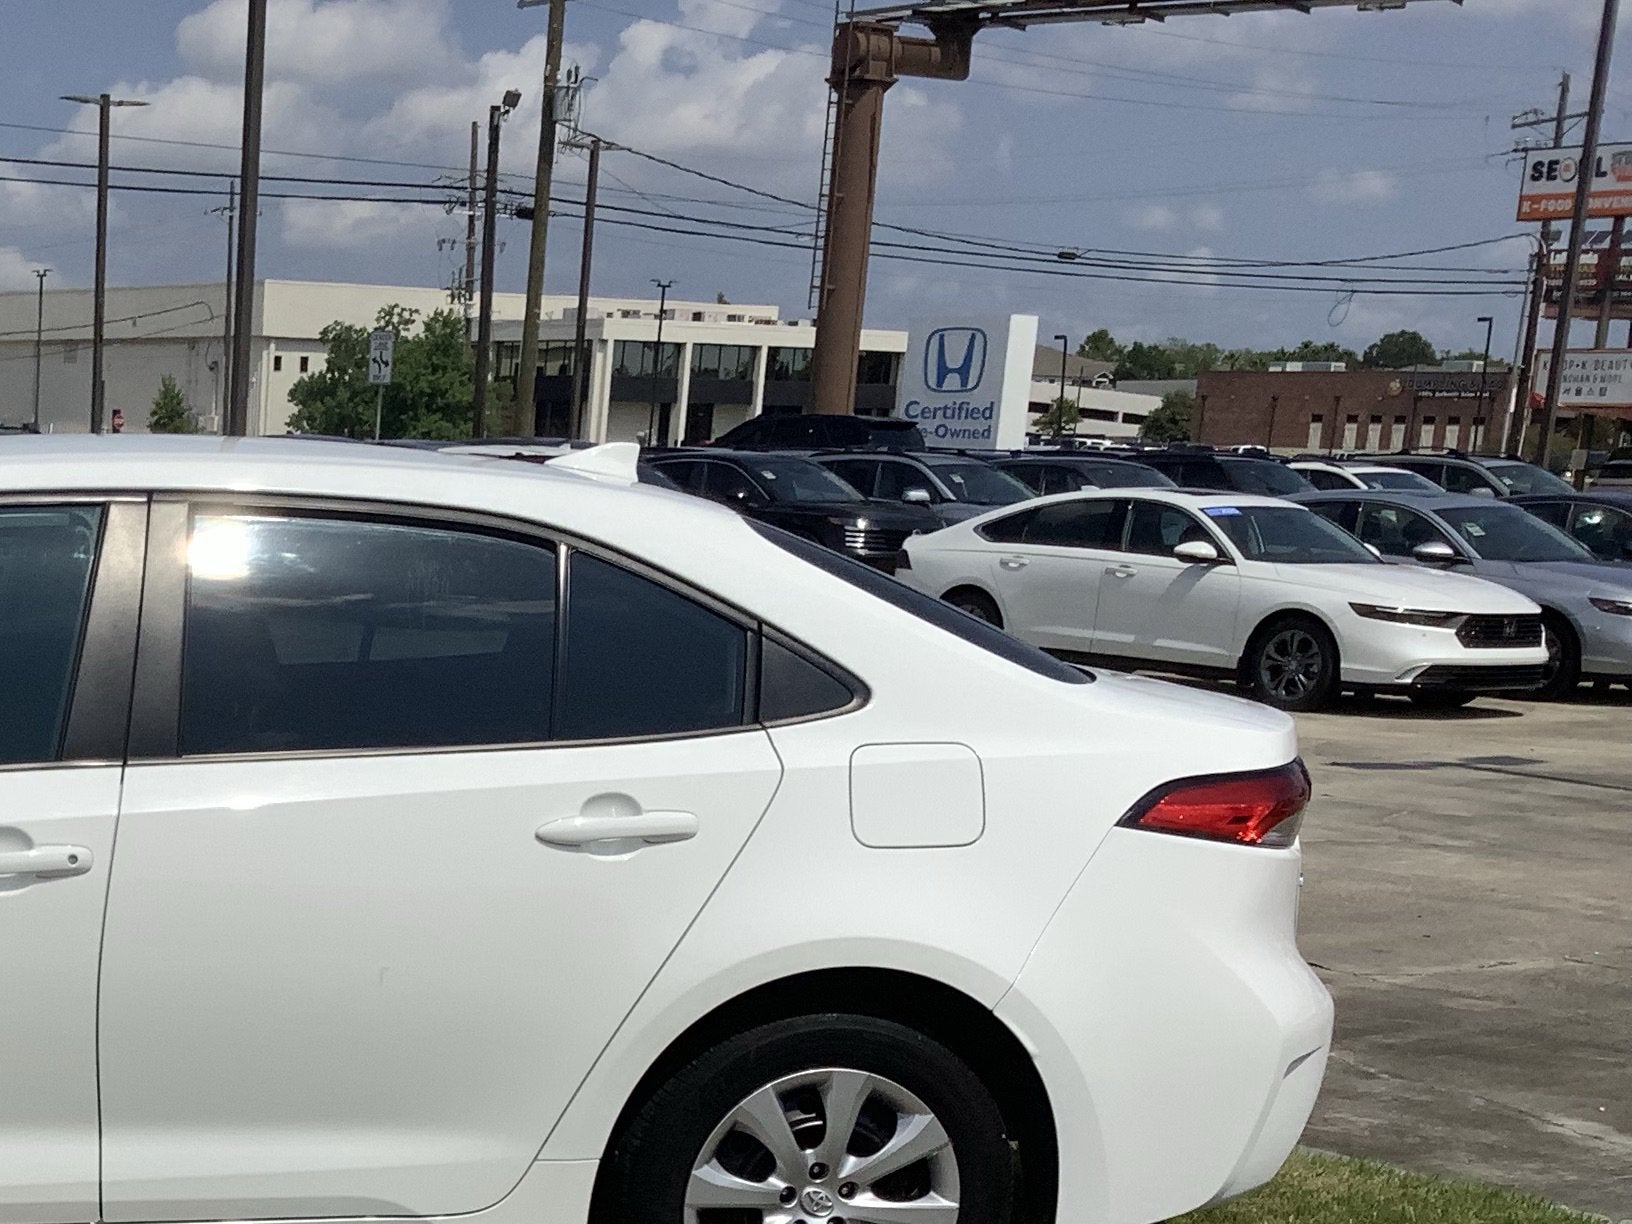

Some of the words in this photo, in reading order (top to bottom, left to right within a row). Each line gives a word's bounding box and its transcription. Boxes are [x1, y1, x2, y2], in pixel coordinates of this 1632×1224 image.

[1531, 156, 1608, 182] SEOL
[904, 400, 995, 421] Certified
[919, 423, 993, 440] e-Owned
